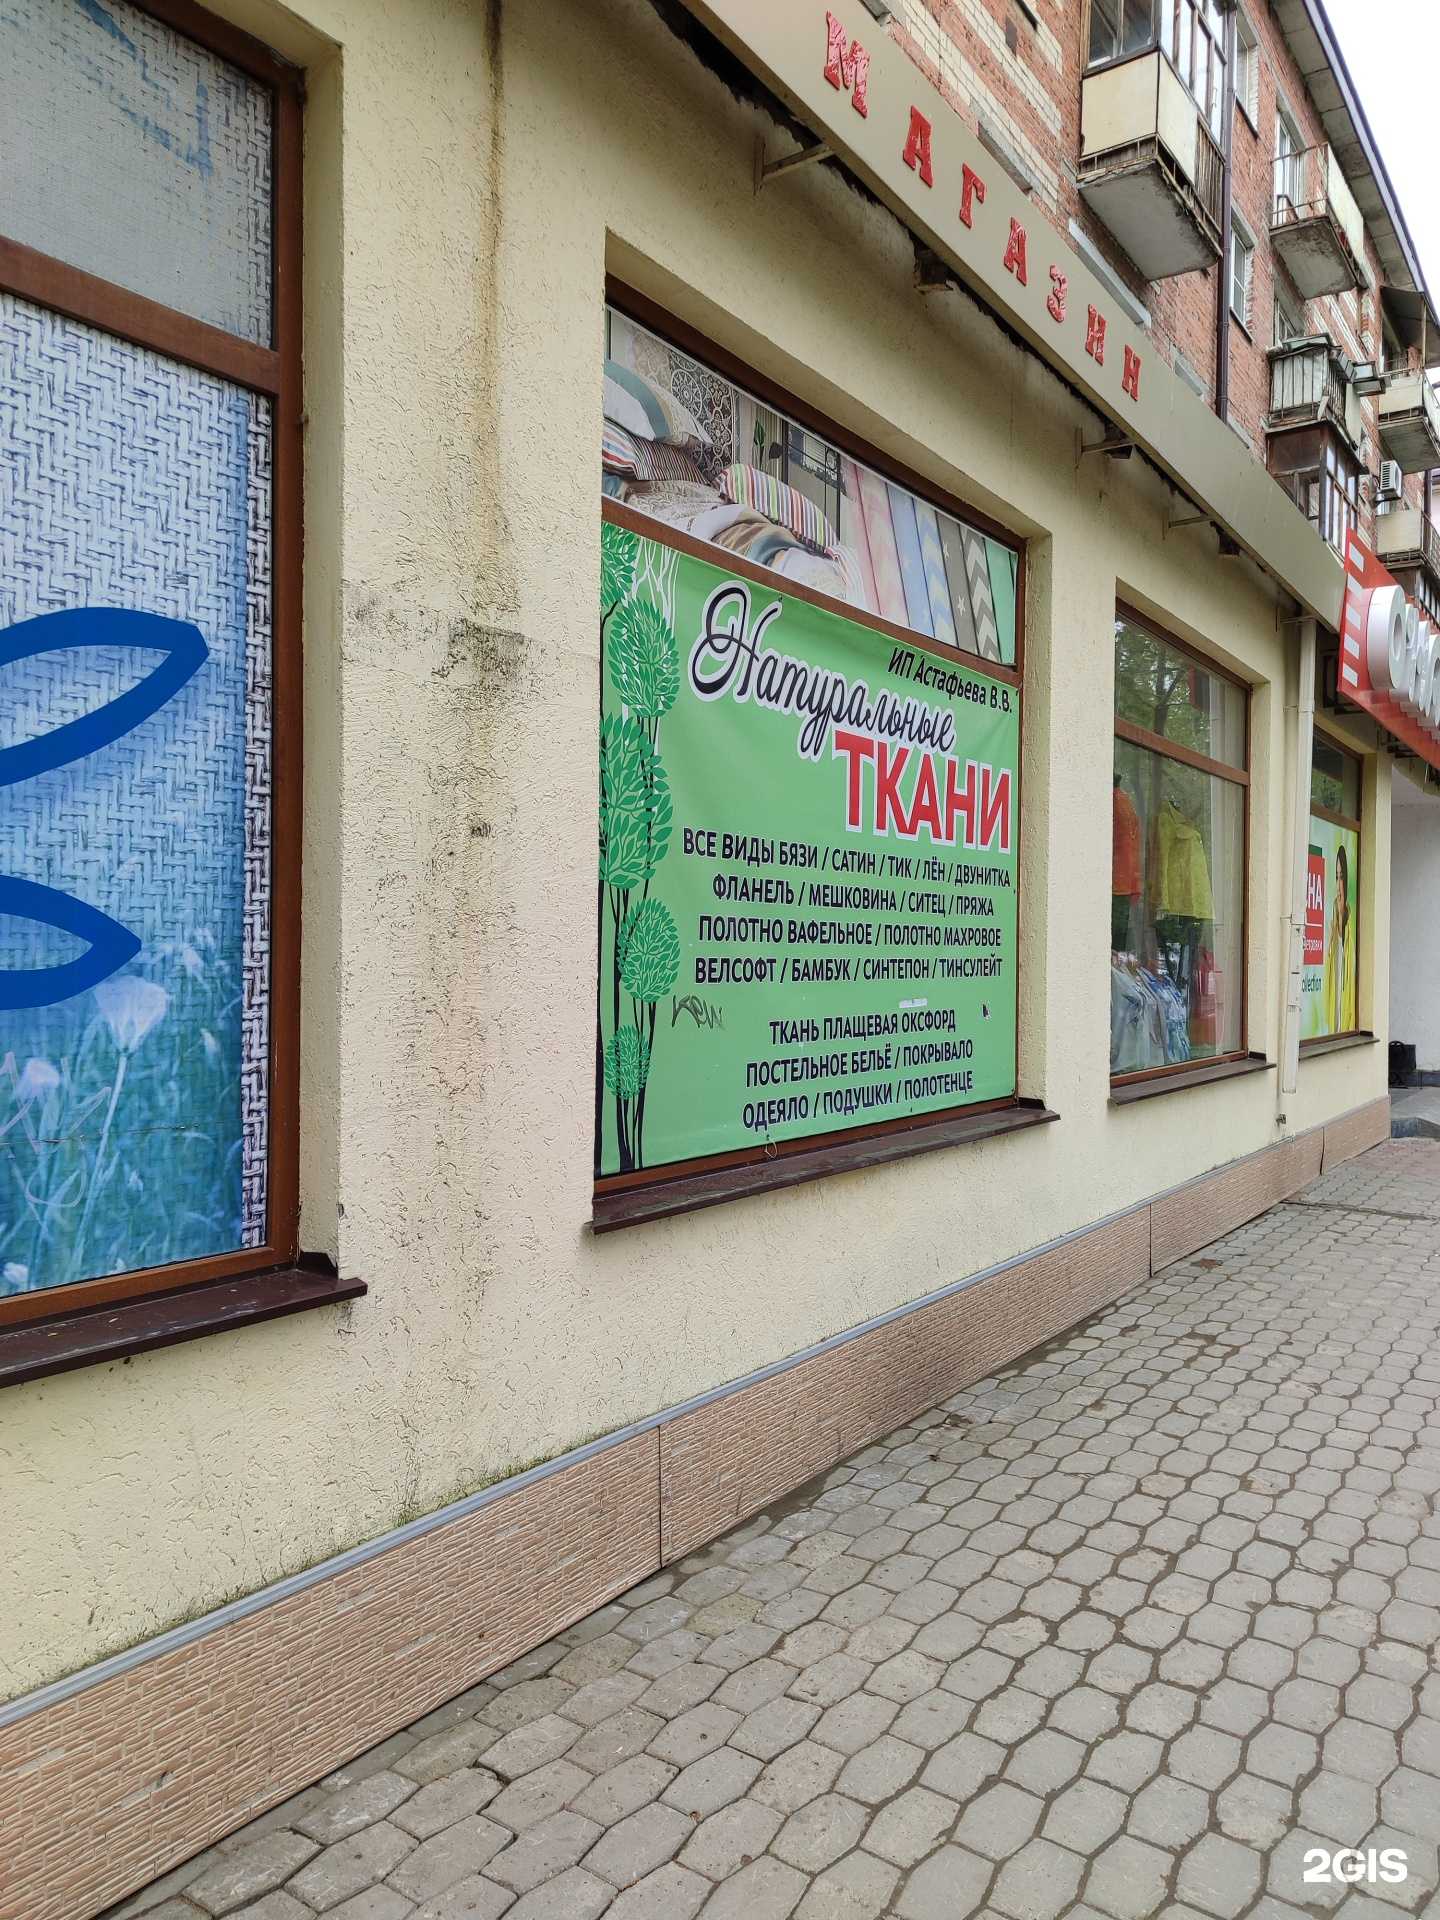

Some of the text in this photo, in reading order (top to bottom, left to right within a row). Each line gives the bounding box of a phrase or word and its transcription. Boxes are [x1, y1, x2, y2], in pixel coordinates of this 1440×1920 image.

[823, 10, 1143, 402] МАГАЗИН
[692, 586, 955, 757] Натуральные
[887, 647, 1013, 714] ИП Астафьева В.В.
[834, 729, 1010, 850] ТКАНИ
[683, 827, 717, 858] ВСЕ
[721, 833, 774, 868] ВИДЫ
[779, 841, 818, 869] БЯЗИ
[832, 848, 876, 875] САТИН
[888, 855, 912, 879] ТИК
[922, 856, 945, 881] ЛЁН
[954, 864, 1011, 887] ДВУНИТКА
[713, 873, 795, 905] ФЛАНЕЛЬ
[808, 883, 897, 911] МЕШКОВИНА
[908, 892, 946, 918] СИТЕЦ
[956, 896, 994, 916] ПРЯЖА
[1306, 871, 1323, 912] НА
[699, 915, 783, 943] ПОЛОТНО
[787, 920, 873, 945] ВАФЕЛЬНОЕ
[884, 924, 941, 946] ПОЛОТНО
[943, 927, 1001, 947] МАХРОВОЕ
[695, 956, 777, 984] ВЕЛСОФТ
[791, 958, 851, 982] БАМБУК
[863, 958, 930, 980] СИНТЕПОН
[938, 953, 1003, 978] ТИНСУЛЕЙТ
[1302, 973, 1322, 993] ollection
[769, 1009, 956, 1045] ТКАНЬ ПЛАЩЕВАЯ ОКСФОРД
[746, 1053, 848, 1088] ПОСТЕЛЬНОЕ
[851, 1043, 892, 1074] БЕЛЬЁ
[903, 1039, 973, 1066] ПОКРЫВАЛО
[742, 1094, 809, 1132] ОДЕЯЛО
[823, 1082, 893, 1116] ПОДУШКИ
[904, 1070, 973, 1100] ПОЛОТЕНЦЕ
